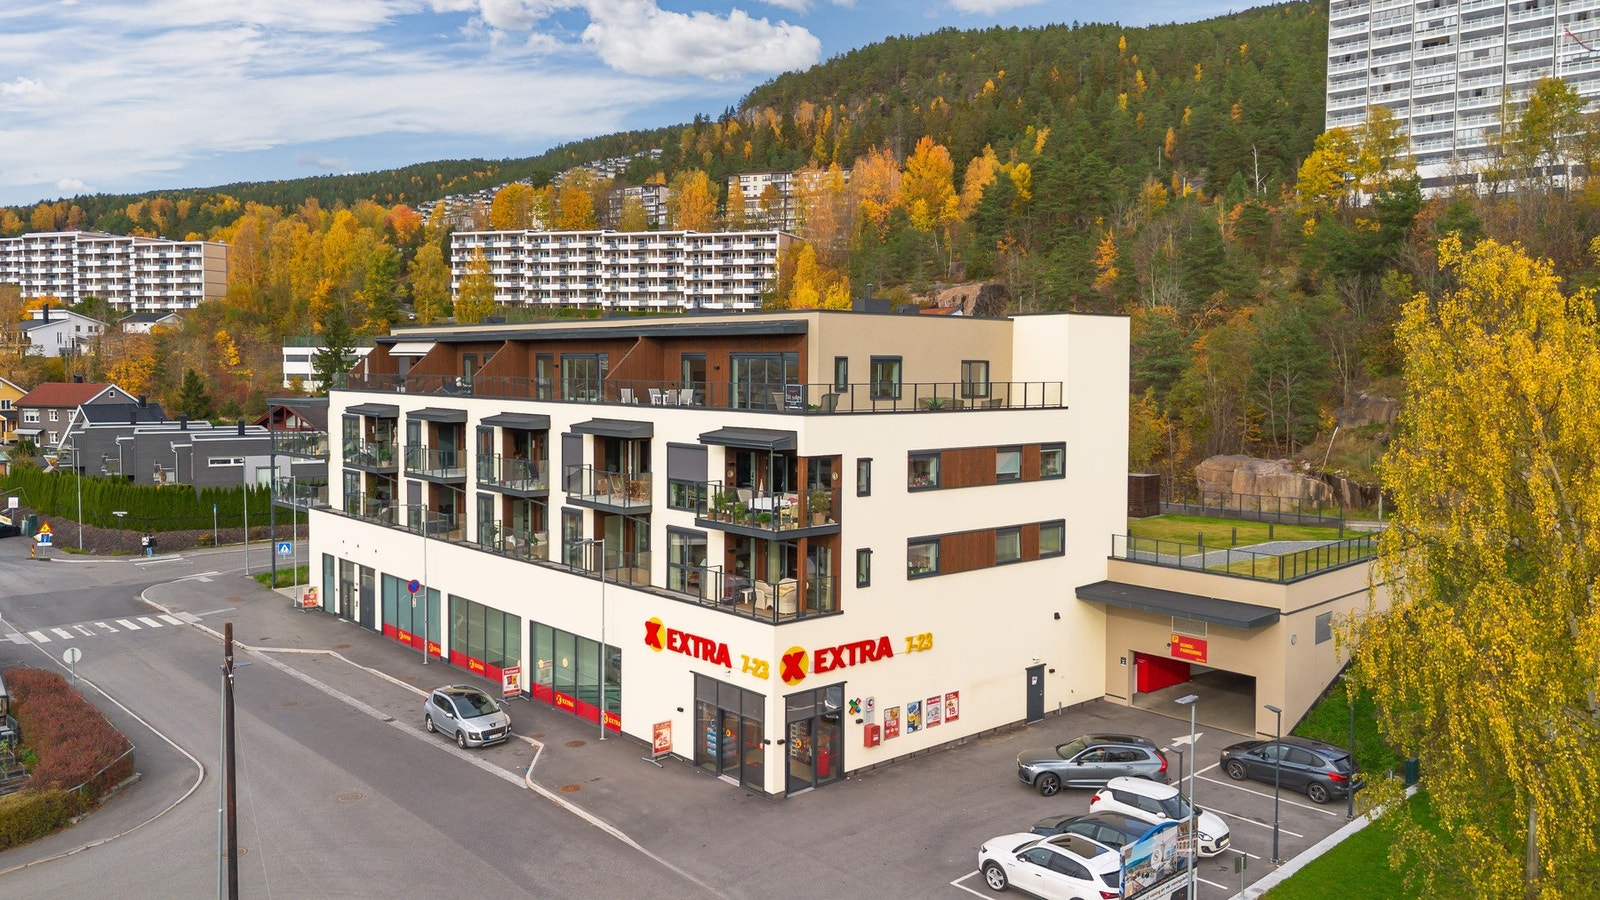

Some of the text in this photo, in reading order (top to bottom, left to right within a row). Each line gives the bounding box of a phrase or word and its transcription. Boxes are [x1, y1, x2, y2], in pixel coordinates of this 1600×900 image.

[667, 627, 733, 669] EXTRA
[741, 654, 769, 680] 7-23
[813, 635, 894, 675] EXTRA
[904, 631, 933, 654] 7-23
